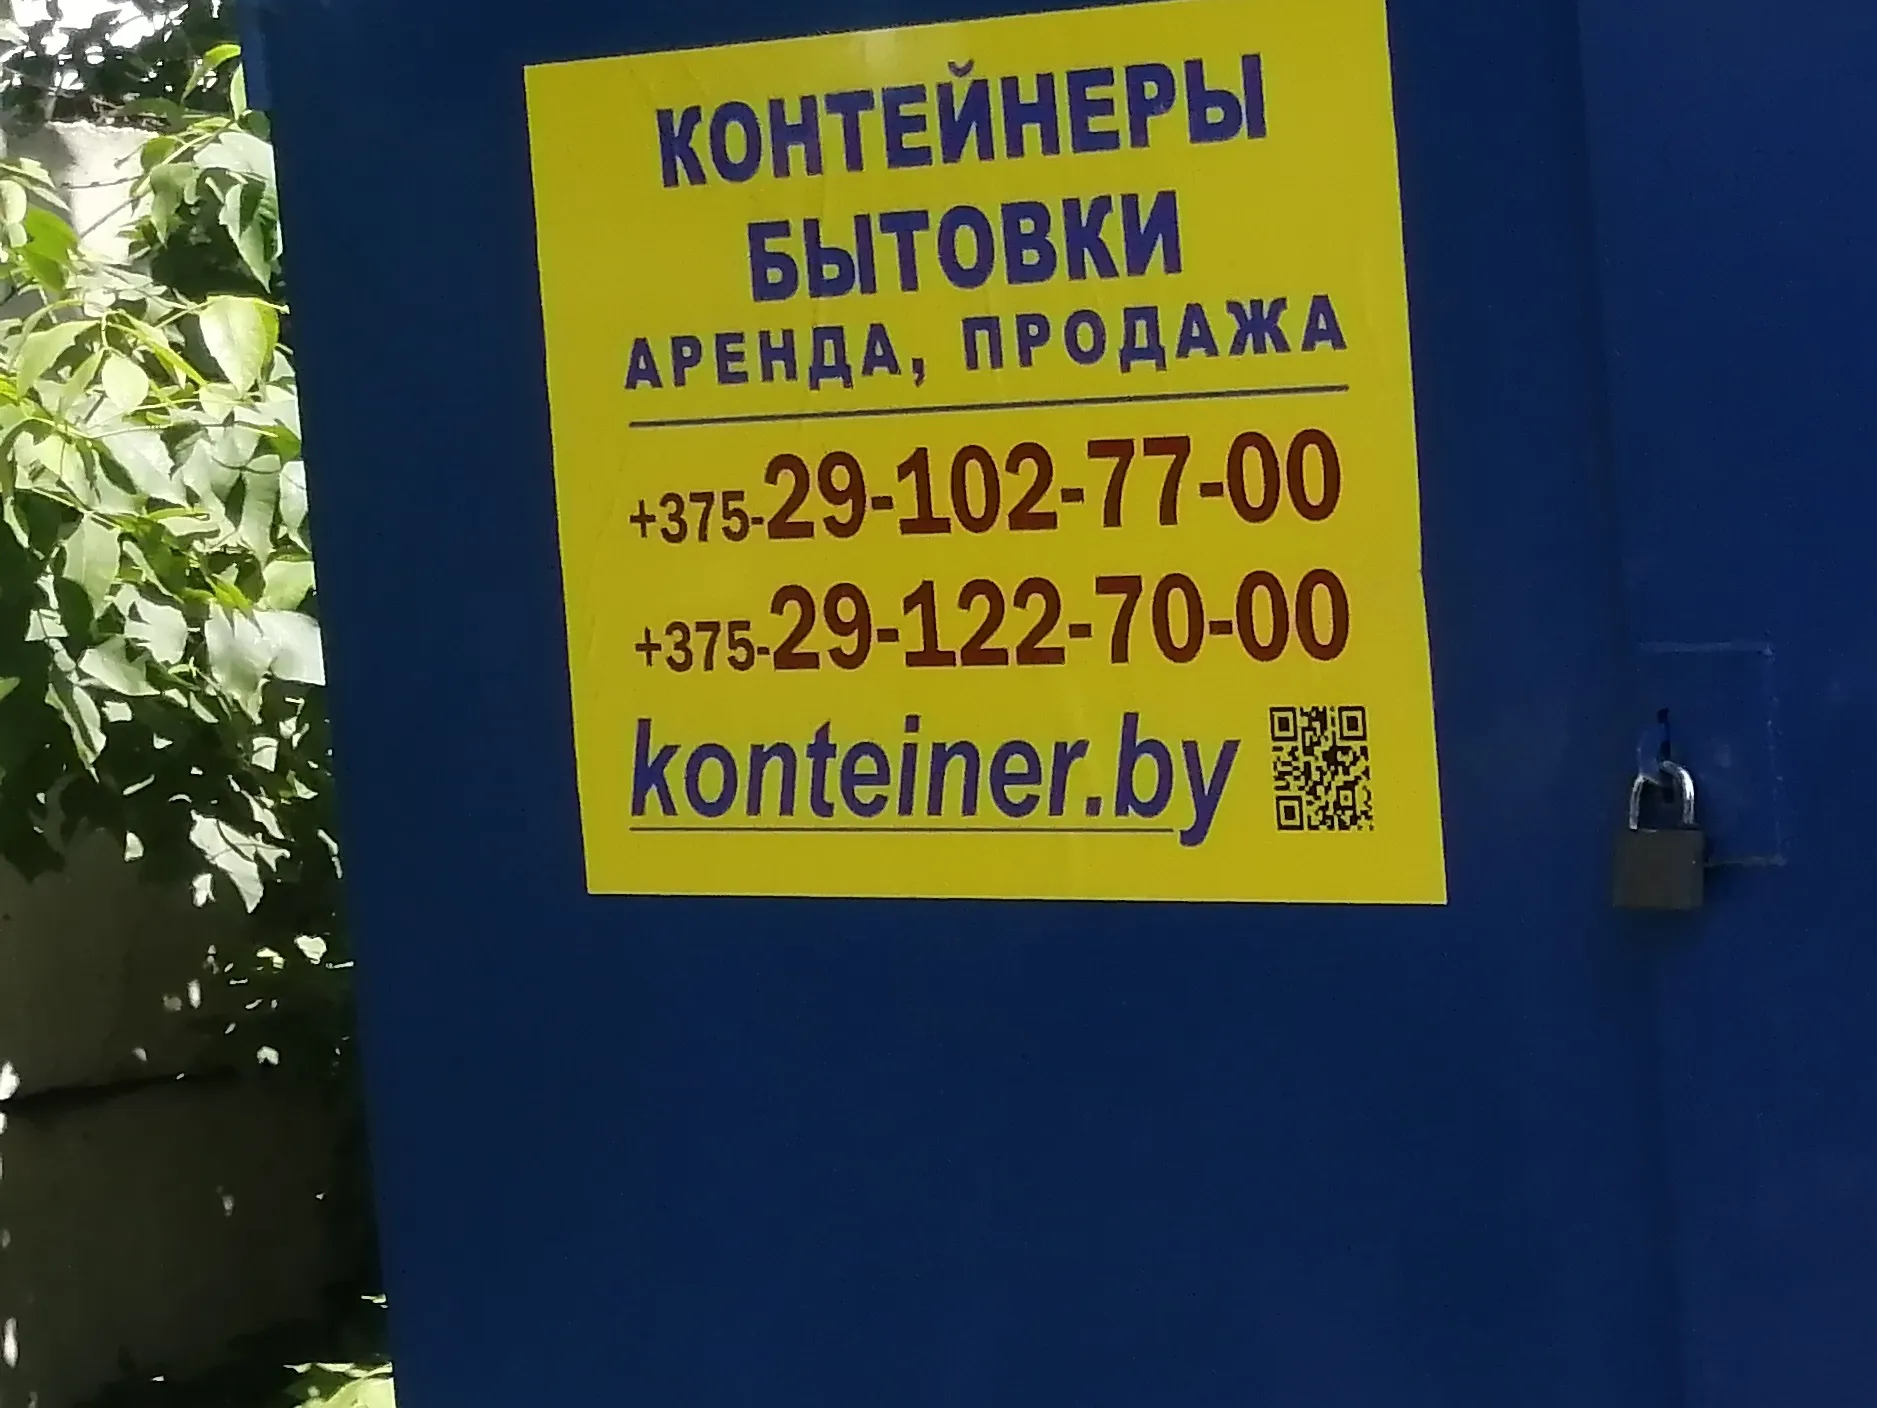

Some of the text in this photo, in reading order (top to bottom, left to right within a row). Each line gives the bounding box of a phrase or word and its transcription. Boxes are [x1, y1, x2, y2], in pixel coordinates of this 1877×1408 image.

[655, 51, 1267, 189] КОНТЕЙНЕРЫ
[747, 189, 1183, 303] БЫТОВКИ
[623, 293, 1348, 392] АРЕНДА, ПРОДАЖА
[628, 428, 1342, 544] +375-29-102-77-00
[634, 568, 1350, 673] +375-29-122-70-00
[630, 711, 1242, 848] konteiner.by
